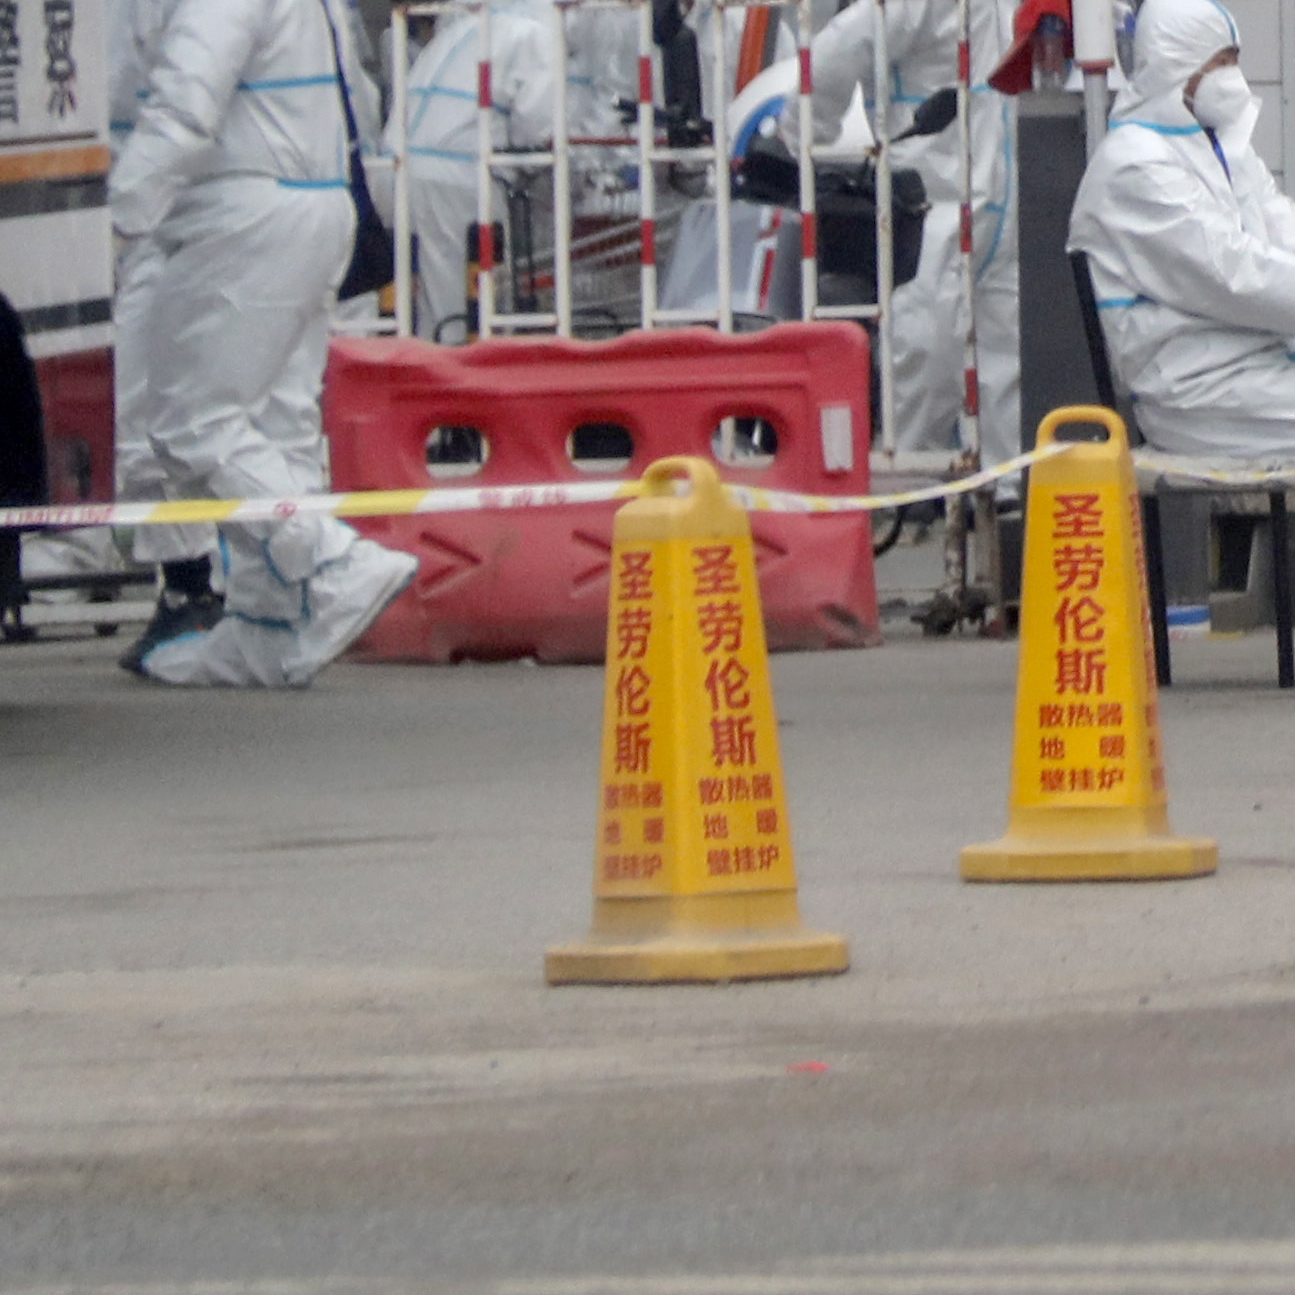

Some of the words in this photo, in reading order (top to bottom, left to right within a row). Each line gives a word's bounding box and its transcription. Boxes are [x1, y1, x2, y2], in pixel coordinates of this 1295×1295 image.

[614, 551, 653, 774] 圣劳伦斯
[692, 546, 757, 767] 圣劳伦斯
[1052, 494, 1107, 695] 圣劳伦斯
[699, 773, 773, 804] 散热器
[1039, 703, 1124, 728] 散热器
